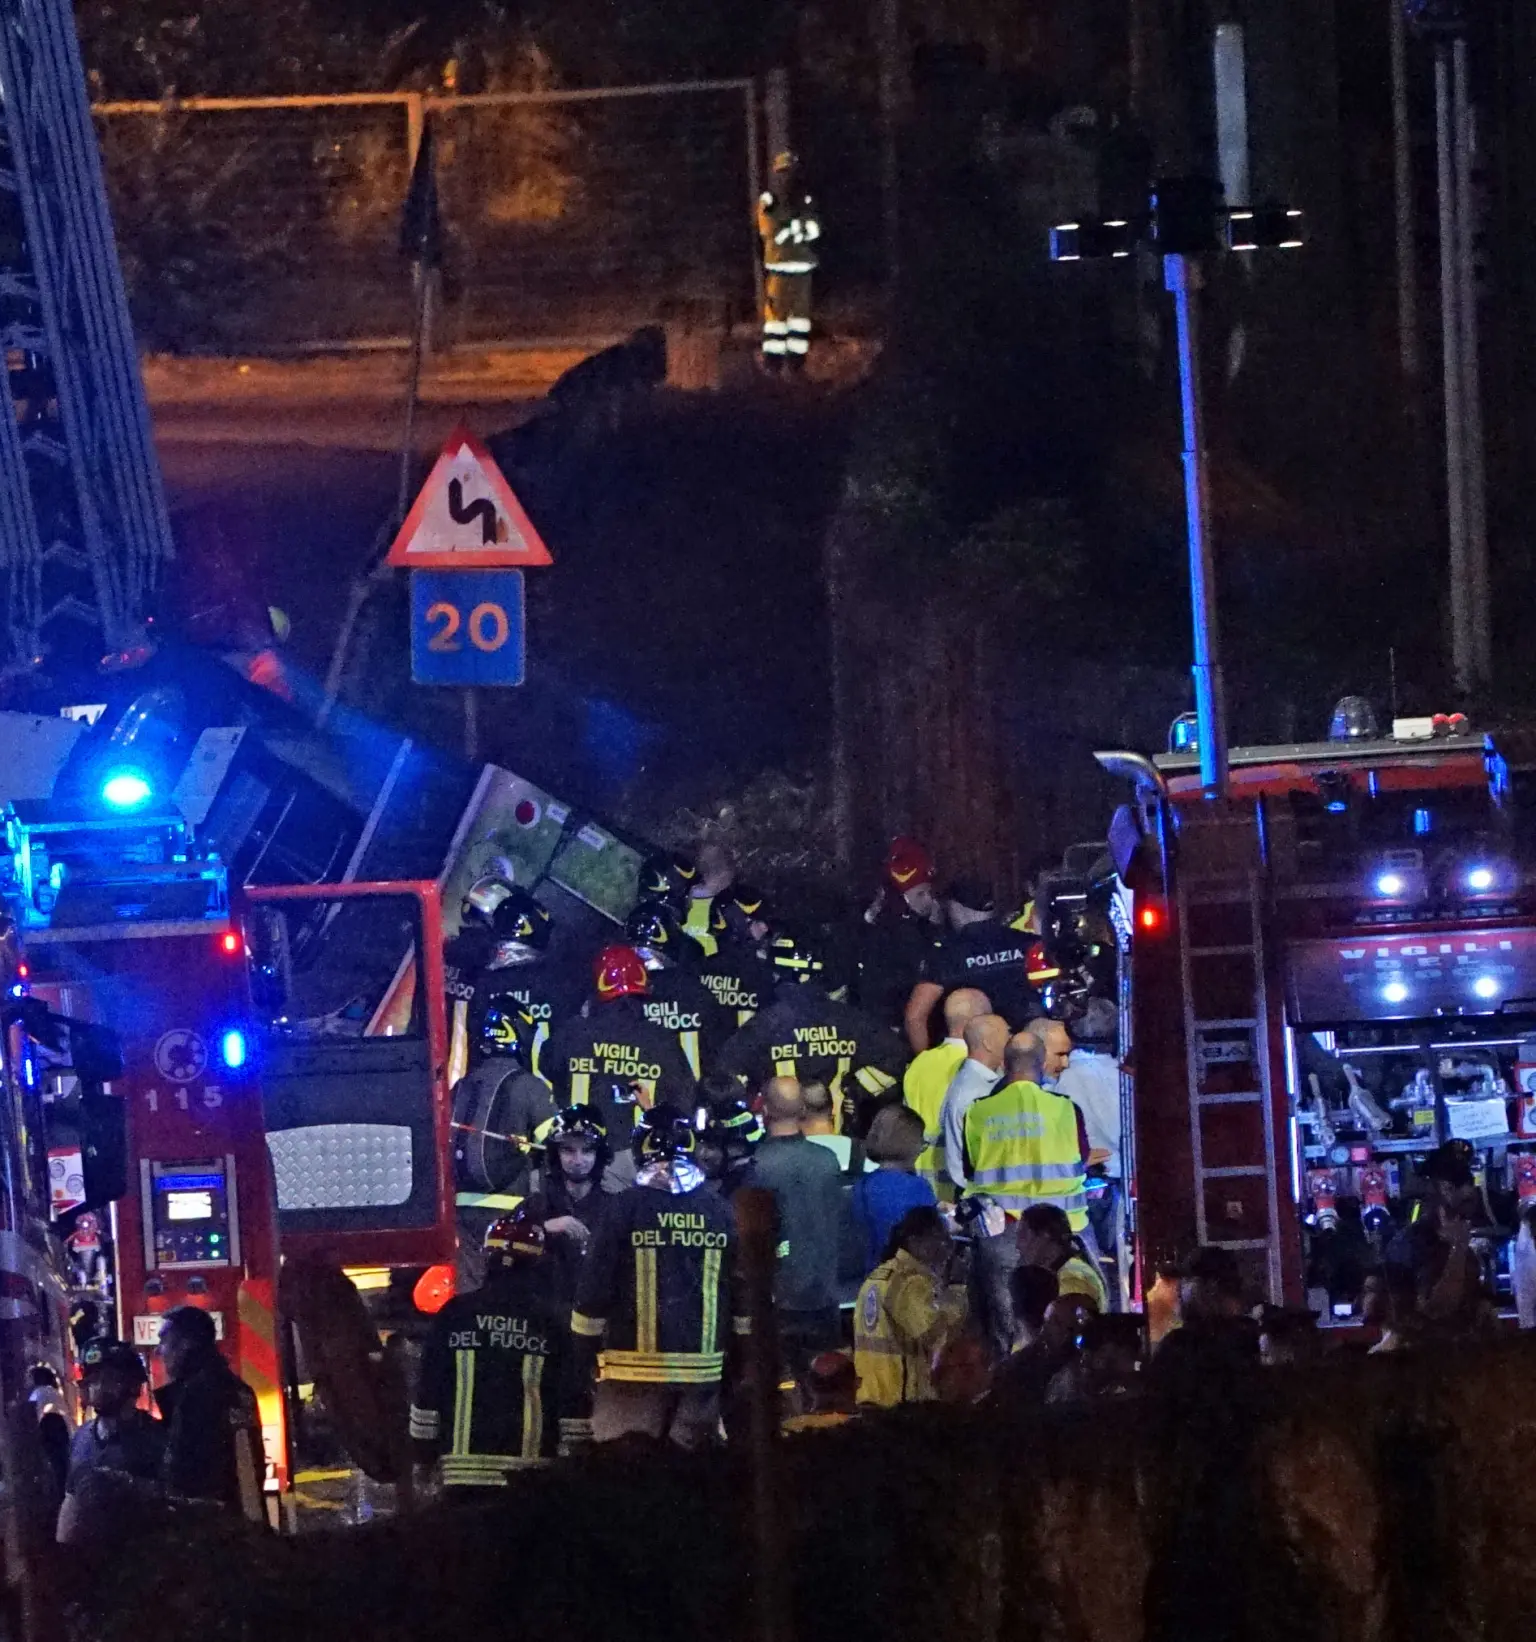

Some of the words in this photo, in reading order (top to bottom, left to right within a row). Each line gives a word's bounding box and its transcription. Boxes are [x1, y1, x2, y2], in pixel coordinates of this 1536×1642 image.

[426, 602, 510, 651] 20
[966, 948, 1024, 968] POLIZIA
[644, 1001, 678, 1017] IGILI
[794, 1026, 837, 1042] VIGILI
[593, 1043, 639, 1060] VIGILI
[771, 1043, 802, 1060] DEL
[809, 1040, 856, 1057] FUOCO
[569, 1058, 598, 1073] DEL
[604, 1059, 661, 1078] FUOCO
[657, 1212, 705, 1229] VIGILI
[632, 1230, 665, 1246] DEL
[671, 1231, 727, 1248] FUOCO
[476, 1314, 527, 1333] VIGILI
[449, 1331, 481, 1348] DEL
